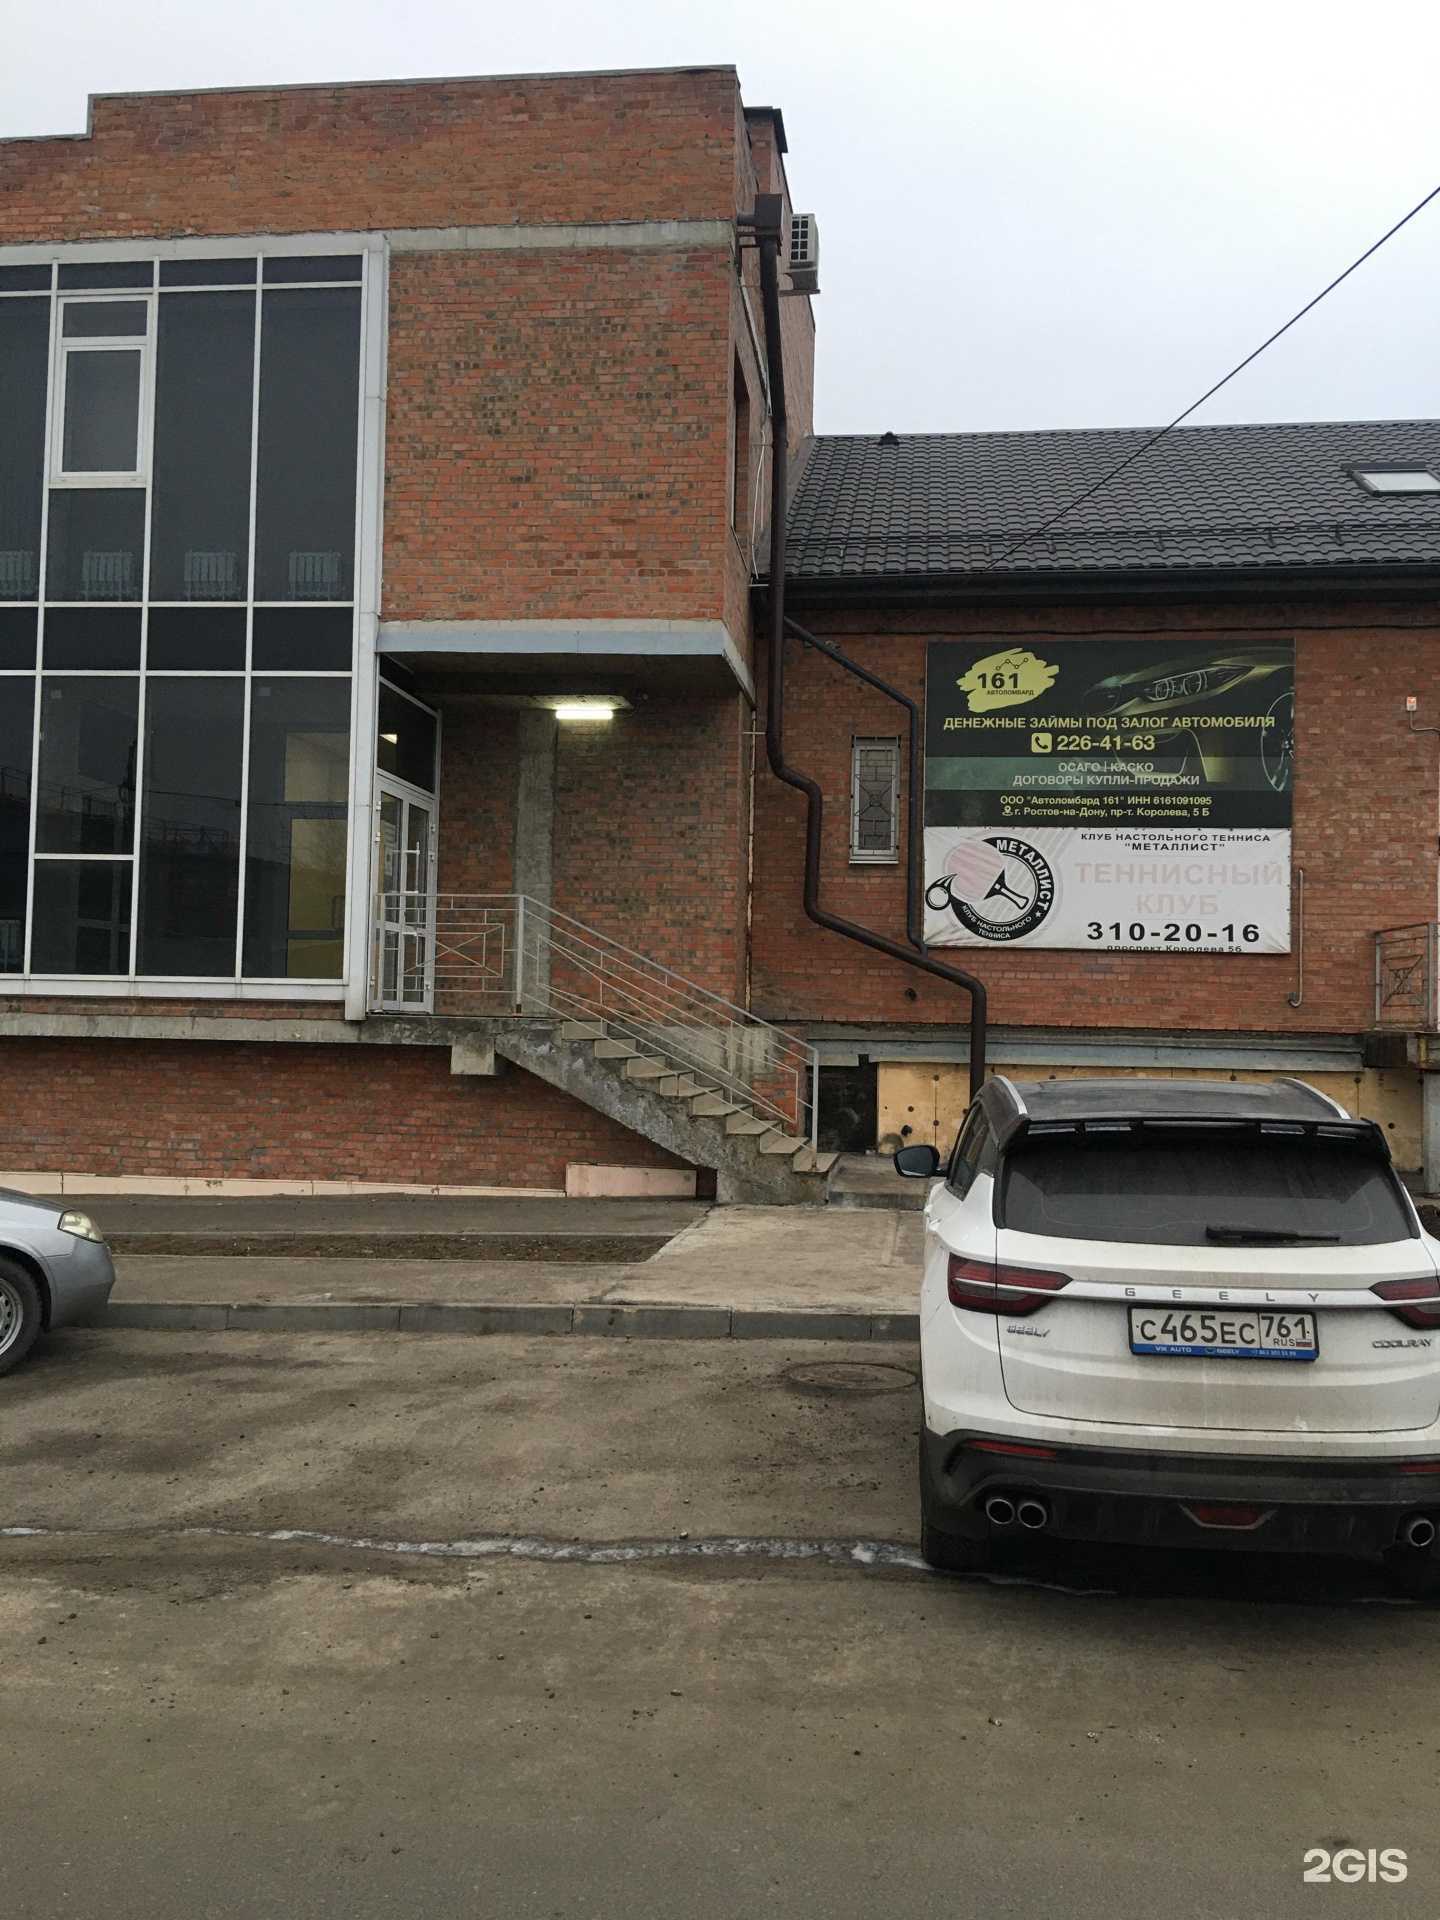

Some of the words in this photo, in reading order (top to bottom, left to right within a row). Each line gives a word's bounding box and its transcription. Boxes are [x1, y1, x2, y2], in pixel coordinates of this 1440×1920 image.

[977, 672, 1019, 689] 161
[943, 717, 1026, 730] ДЕНЕЖНЫЕ
[1029, 715, 1082, 729] ЗАЙМЫ
[1086, 717, 1118, 730] ПОД
[1121, 716, 1169, 729] ЗАЛОГ
[1172, 716, 1276, 729] АВТОМОБИЛЯ
[1056, 735, 1156, 751] 226-41-63
[1058, 762, 1101, 773] ОСАГО
[1110, 762, 1154, 773] КАСКО
[1012, 775, 1084, 787] ДОГОВОРЫ
[1086, 775, 1200, 787] КУПЛИ-ПРОДАЖИ
[1000, 795, 1024, 805] ООО
[1026, 795, 1100, 806] "Автоломбард
[1102, 796, 1125, 805] 161"
[1127, 796, 1150, 805] ИНН
[1024, 807, 1108, 818] Ростов-на-Дону,
[1111, 809, 1134, 818] пр-т.
[1137, 807, 1190, 818] Королева,
[1193, 808, 1200, 816] 5
[1202, 808, 1210, 816] Б
[1081, 833, 1112, 841] КЛУБ
[1115, 833, 1208, 842] НАСТОЛЬНОГО
[1212, 834, 1271, 842] ТЕННИСА
[1125, 842, 1225, 851] "МЕТАЛЛИСТ"
[996, 839, 1052, 910] МЕТАЛЛИСТ
[1074, 861, 1283, 885] ТЕННИСНЫЙ
[1136, 894, 1219, 914] КЛУБ
[961, 905, 977, 923] КЛУБ
[976, 916, 1032, 933] НАСТОЛЬНОГО
[978, 928, 1011, 939] ТЕННИСА
[1087, 922, 1259, 943] 310-20-16
[1124, 1287, 1319, 1303] GEELY
[1261, 1316, 1307, 1339] 761
[1273, 1338, 1296, 1347] RUS
